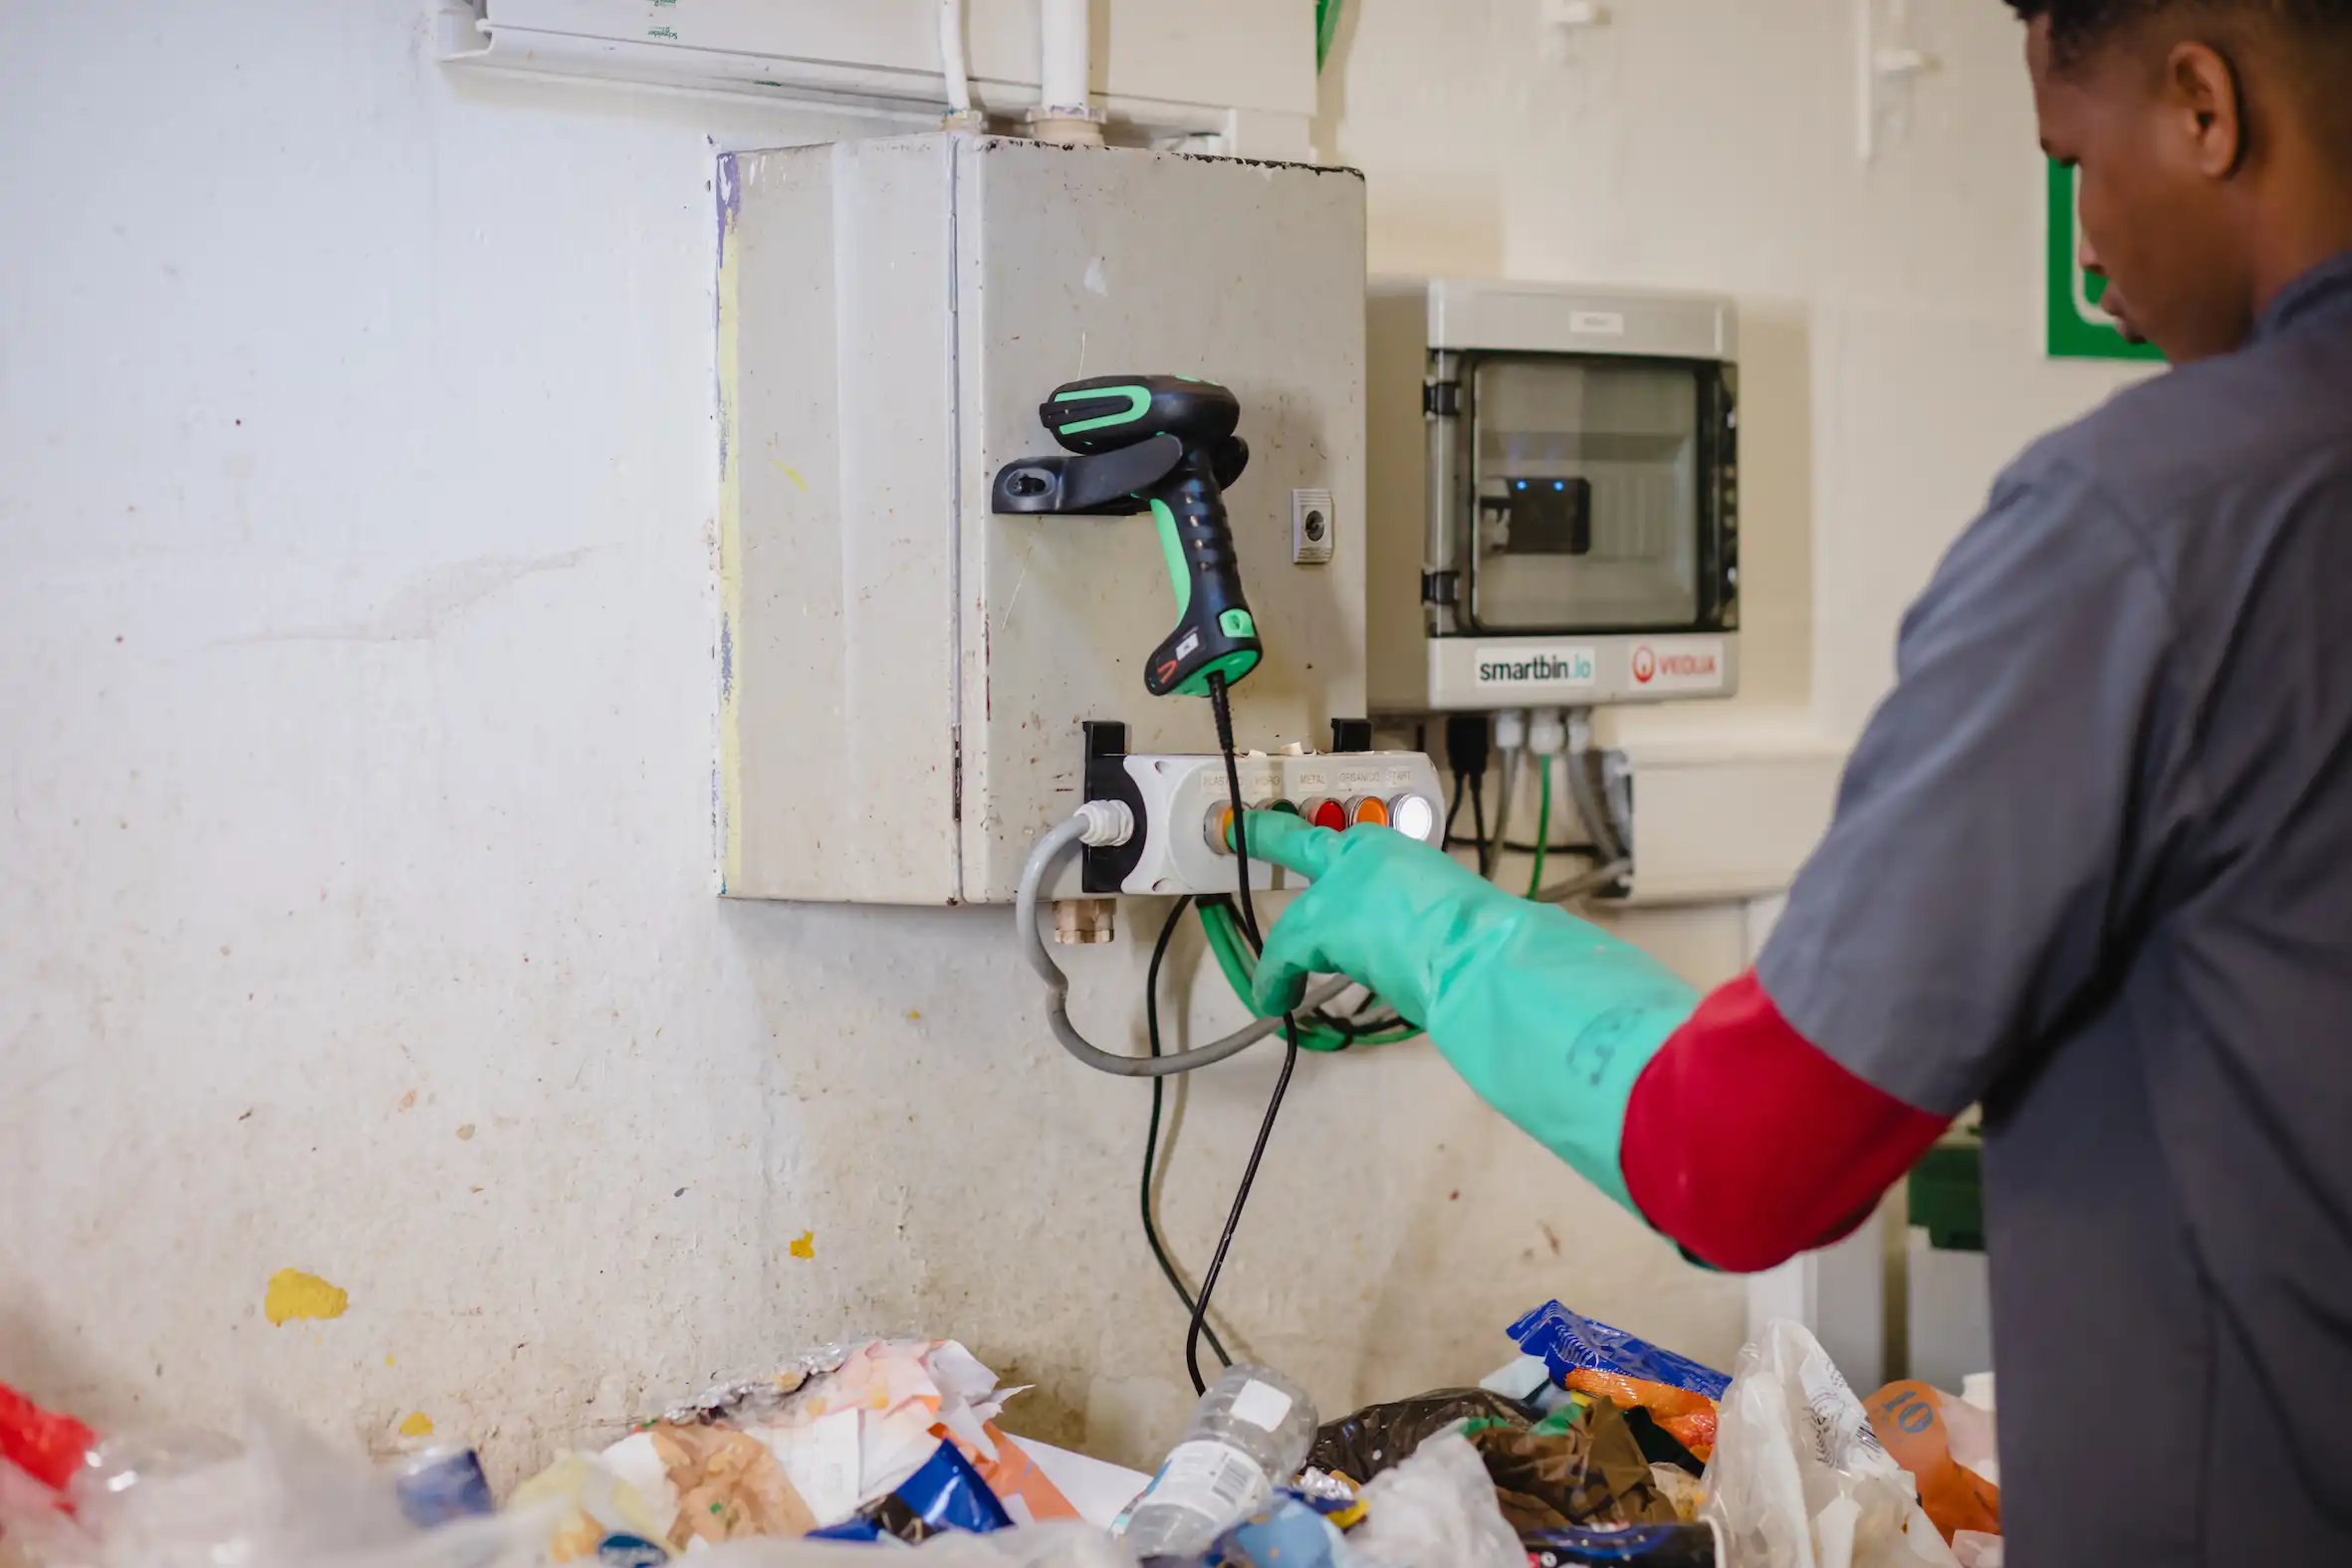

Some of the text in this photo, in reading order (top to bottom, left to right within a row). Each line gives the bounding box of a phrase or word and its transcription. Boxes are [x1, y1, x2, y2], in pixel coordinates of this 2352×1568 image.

[1480, 654, 1591, 681] smartbin.io
[1660, 655, 1716, 675] VEOLIA
[1299, 773, 1326, 784] METAL
